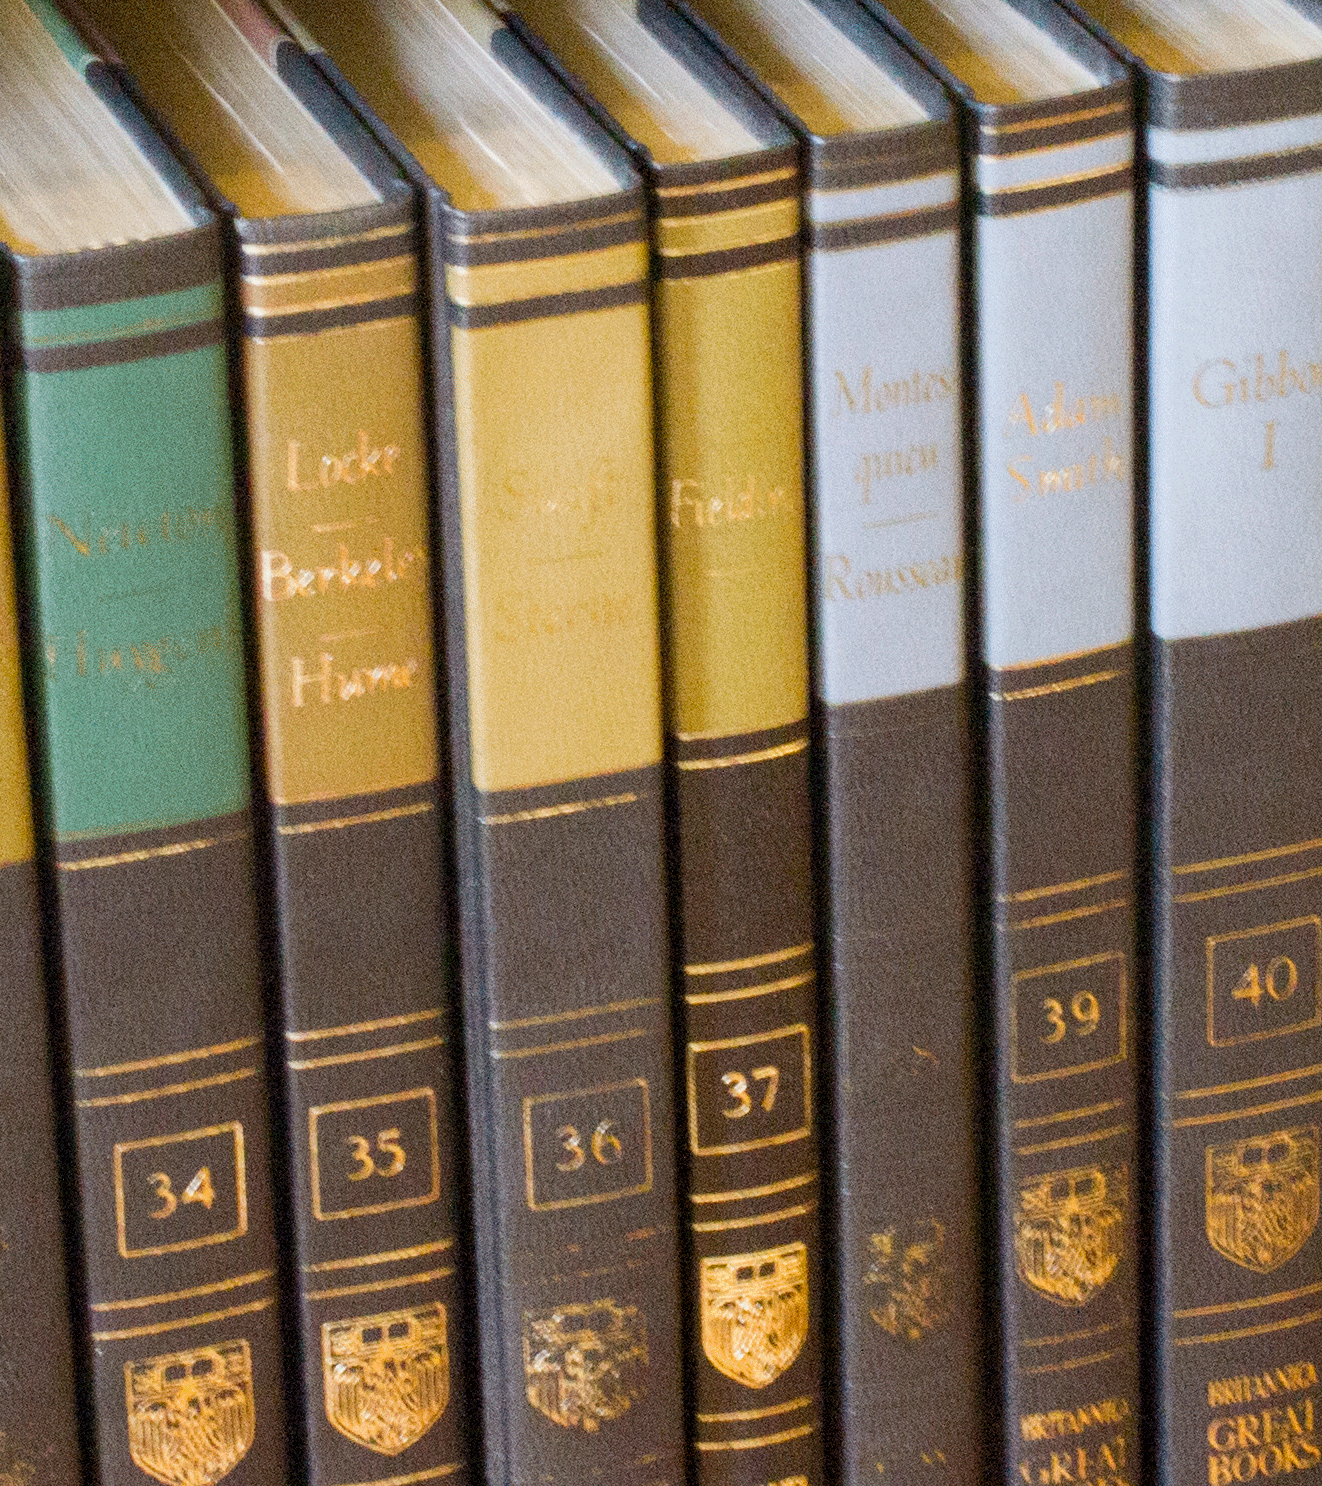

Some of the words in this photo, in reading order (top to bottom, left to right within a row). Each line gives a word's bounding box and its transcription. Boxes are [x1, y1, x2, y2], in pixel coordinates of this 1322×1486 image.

[1260, 420, 1280, 472] I
[1229, 953, 1299, 1009] 40
[1039, 988, 1101, 1046] 39
[719, 1064, 781, 1121] 37
[345, 1125, 409, 1183] 35
[553, 1116, 624, 1173] 36
[145, 1164, 217, 1220] 34
[1206, 1399, 1316, 1451] GREAT
[1206, 1437, 1322, 1486] BOOKS
